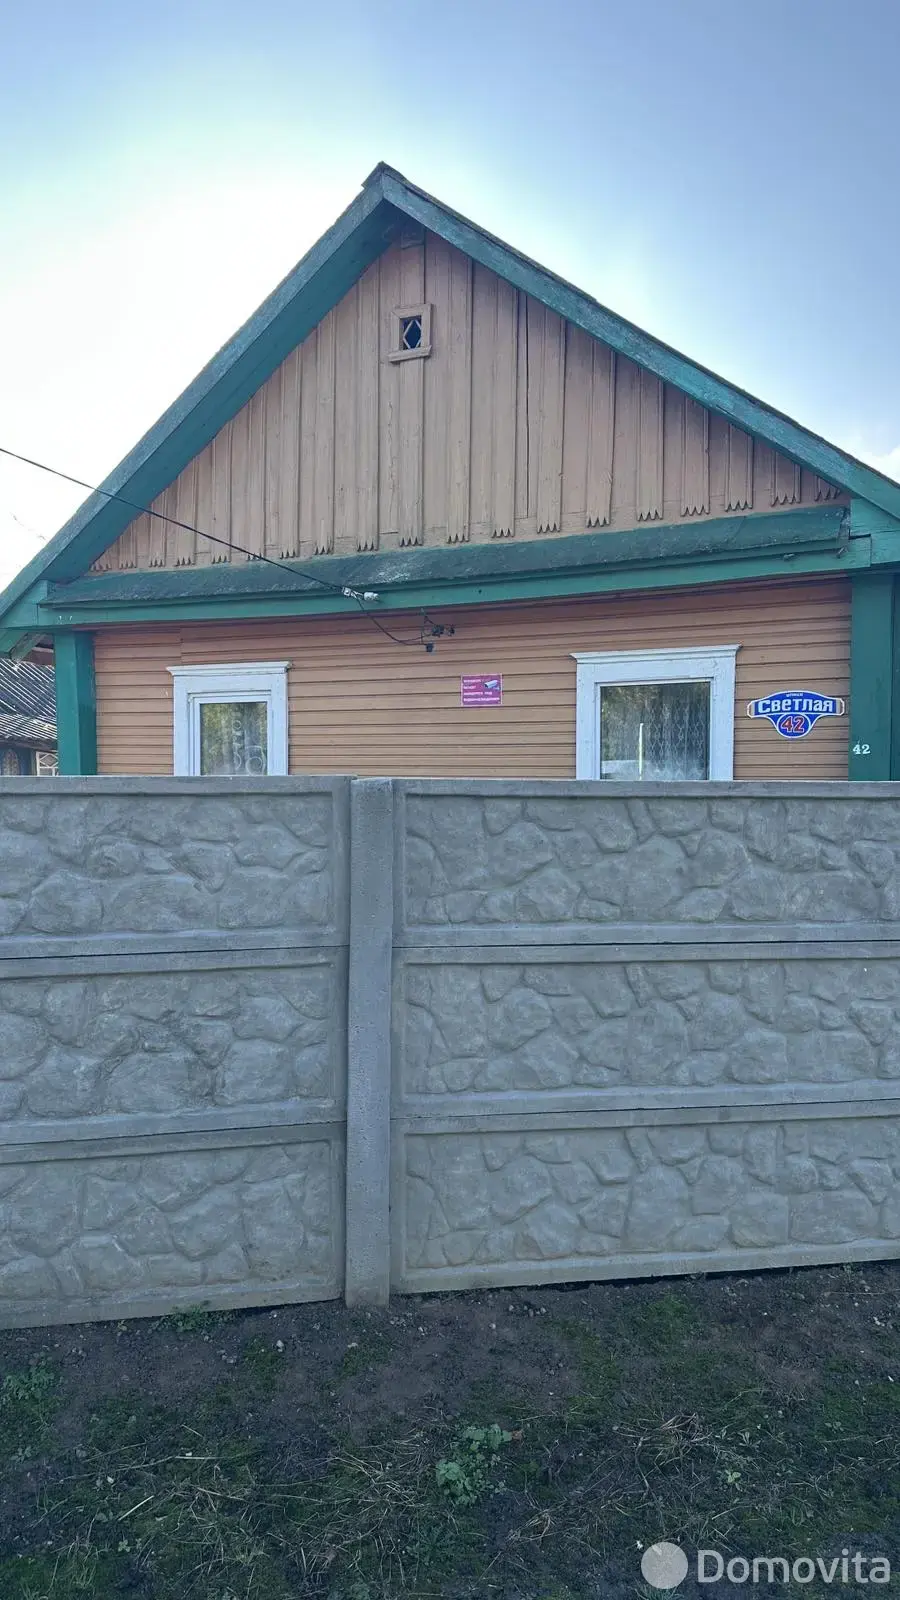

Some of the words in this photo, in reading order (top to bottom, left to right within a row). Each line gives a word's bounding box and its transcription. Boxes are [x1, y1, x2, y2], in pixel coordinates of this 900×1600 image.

[758, 698, 834, 713] Светлая
[781, 716, 805, 733] 42
[852, 744, 871, 755] 42
